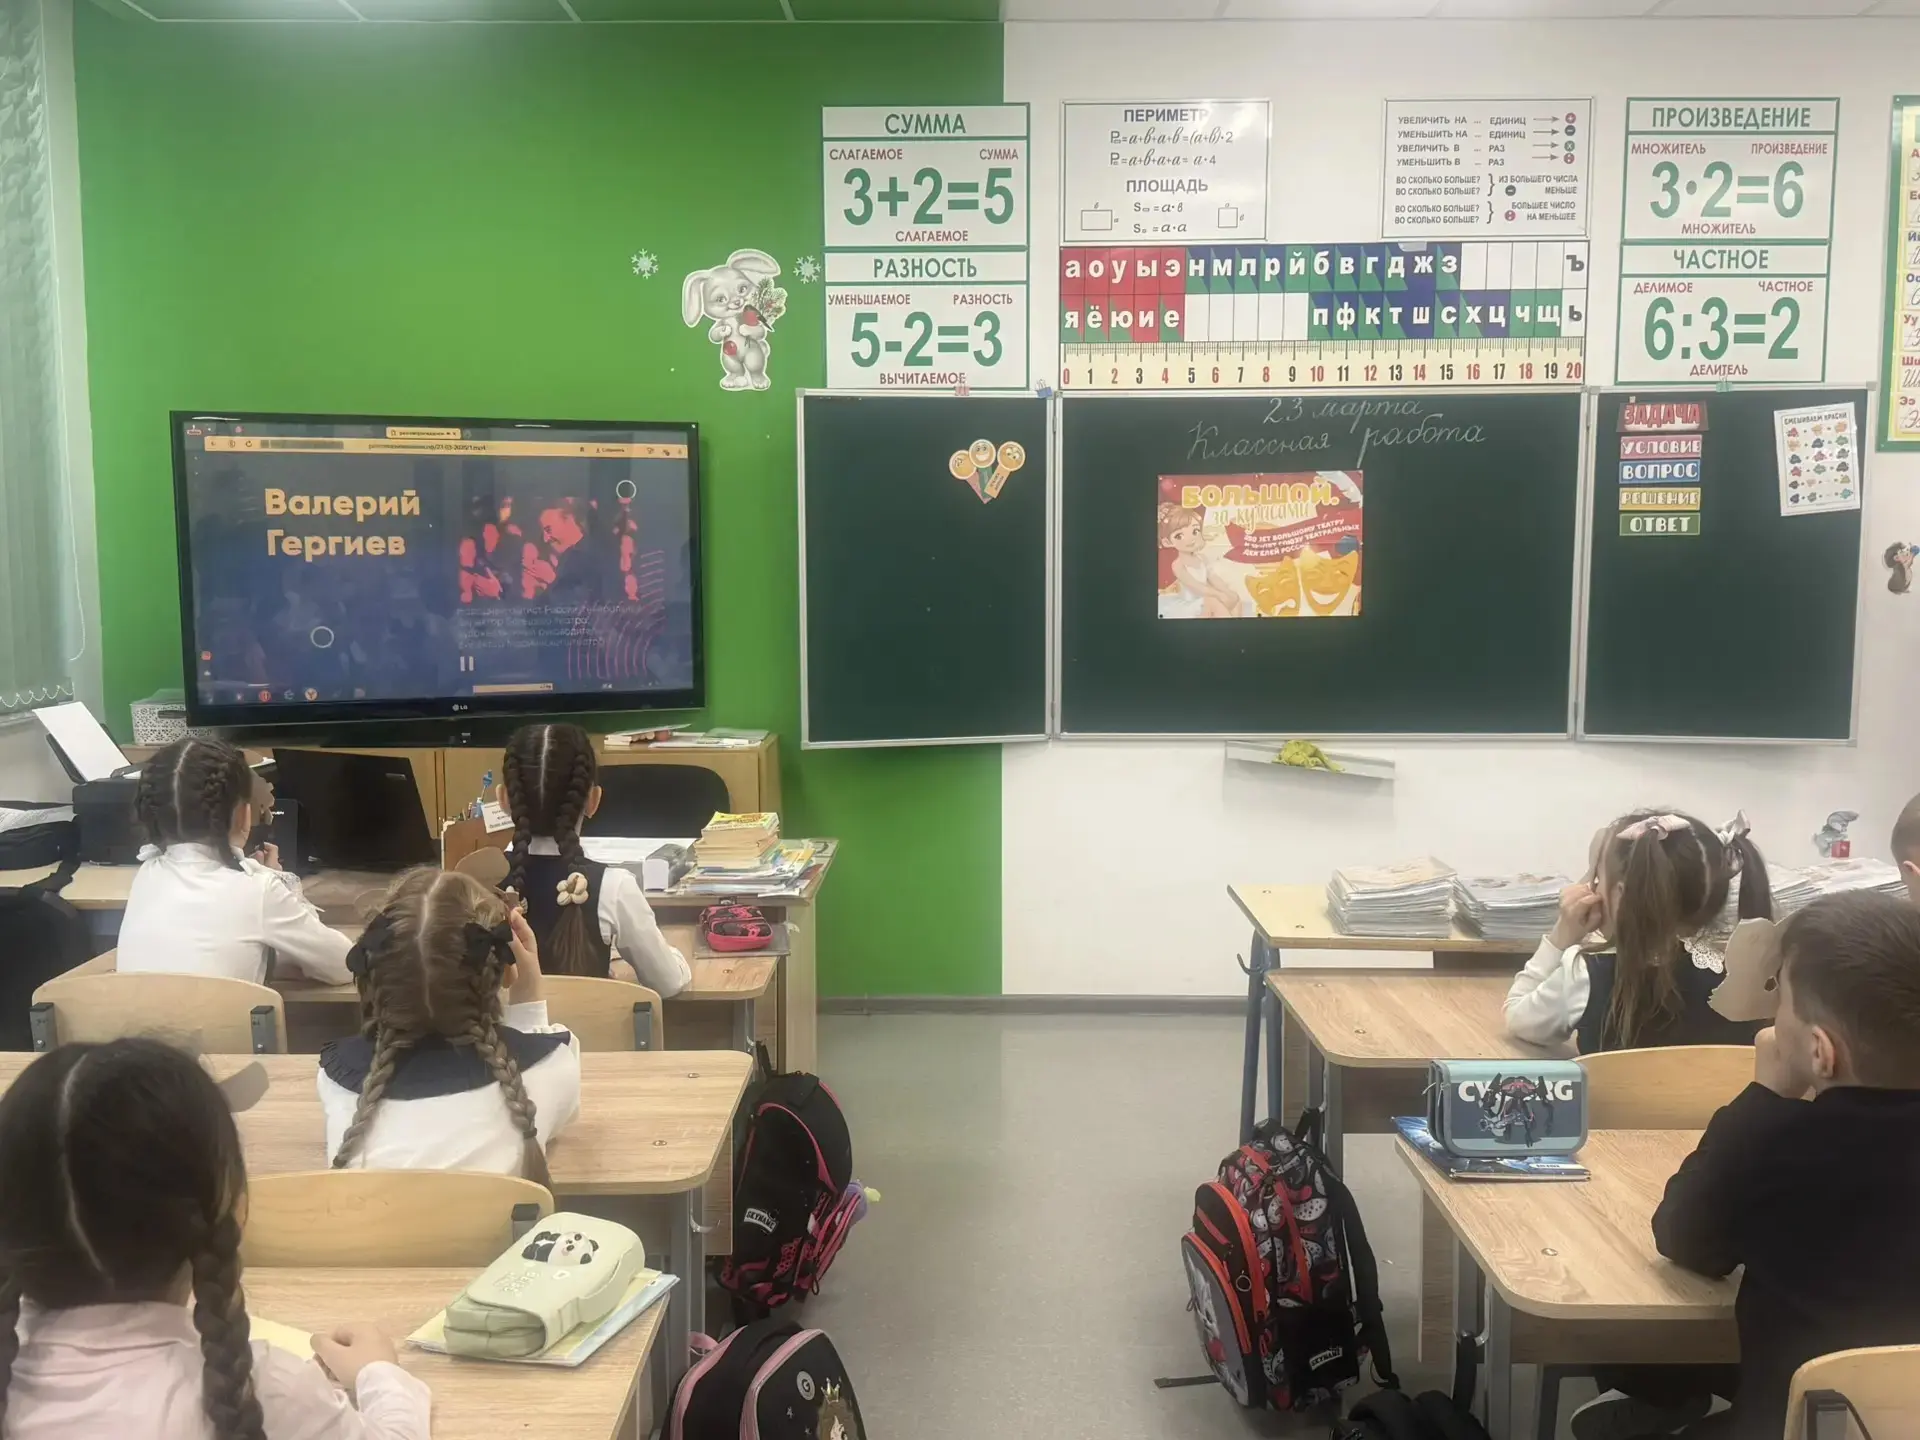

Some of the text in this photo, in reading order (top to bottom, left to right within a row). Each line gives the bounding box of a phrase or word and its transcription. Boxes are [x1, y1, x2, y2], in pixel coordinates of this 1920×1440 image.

[1124, 108, 1209, 123] ПЕРИМЕТР
[1398, 116, 1526, 126] УВЕЛИЧИТЬ НА ЕДИНИЦ
[1652, 107, 1811, 130] ПРОИЗВЕДЕНИЕ
[885, 113, 967, 135] СУММА
[1398, 130, 1453, 138] УМЕНЬШИТЬ
[1489, 131, 1526, 140] ЕДИНИЦ
[829, 148, 1019, 161] СЛАГАЕМОЕ СУММА
[1397, 144, 1449, 152] УВЕЛИЧИТЬ
[1454, 144, 1460, 152] В
[1631, 142, 1828, 156] МНОЖИТЕЛЬ ПРОИЗВЕДЕНИЕ
[1397, 158, 1505, 166] УМЕНЬШИТЬ В РАЗ
[1127, 179, 1208, 193] ПЛОЩАДЬ
[1396, 176, 1406, 184] ВО
[1408, 176, 1443, 184] СКОЛЬКО
[1444, 176, 1480, 184] БОЛЬШЕ?
[1510, 175, 1551, 183] БОЛЬШЕГО
[1553, 175, 1578, 183] ЧИСЛА
[1396, 187, 1406, 195] ВО
[1408, 187, 1442, 195] СКОЛЬКО
[1444, 187, 1480, 195] БОЛЬШЕ?
[1395, 201, 1576, 213] ВО СКОЛЬКО БОЛЬШЕ? БОЛЬШЕЕ ЧИСЛО
[1395, 212, 1576, 224] ВО СКОЛЬКО БОЛЬШЕ? НА МЕНЬШЕЕ
[895, 230, 968, 243] СЛАГАЕМОЕ
[1681, 222, 1756, 236] МНОЖИТЕЛЬ
[1065, 260, 1080, 277] а
[1088, 260, 1104, 277] о
[1112, 260, 1127, 283] у
[1137, 259, 1157, 276] ы
[1165, 259, 1181, 276] э
[1189, 258, 1205, 276] н
[1212, 258, 1232, 276] м
[1239, 258, 1257, 276] л
[1265, 258, 1281, 282] р
[1289, 251, 1305, 275] й
[1313, 251, 1329, 275] б
[1339, 256, 1355, 274] в
[1366, 256, 1378, 274] г
[1388, 256, 1405, 278] д
[1413, 256, 1433, 274] ж
[1441, 255, 1458, 273] з
[1673, 249, 1769, 270] ЧАСТНОЕ
[873, 258, 977, 279] РАЗНОСТЬ
[1633, 280, 1814, 295] ДЕЛИМОЕ ЧАСТНОЕ
[828, 292, 1013, 306] УМЕНЬШАЕМОЕ РАЗНОСТЬ
[1064, 311, 1079, 328] я
[1087, 306, 1102, 328] ё
[1111, 310, 1133, 328] ю
[1139, 310, 1154, 327] и
[1164, 310, 1179, 328] е
[1313, 308, 1328, 326] п
[1336, 302, 1356, 331] ф
[1365, 307, 1381, 325] к
[1389, 307, 1403, 324] т
[1413, 307, 1430, 324] ш
[1441, 306, 1457, 324] с
[1465, 306, 1482, 323] х
[1490, 306, 1506, 327] ц
[1515, 306, 1530, 322] ч
[1537, 305, 1560, 326] щ
[1063, 362, 1582, 384] 0 1 2 3 4 5 6 7 8 9 10 11 12 13 14 15 16 17 18 19 20
[1690, 363, 1749, 377] ДЕЛИТЕЛЬ
[879, 372, 966, 386] ВЫЧИТАЕМОЕ
[1263, 397, 1424, 434] 23 марта
[1624, 403, 1700, 427] ЗАДАЧА
[1187, 413, 1487, 468] Классная работа
[1623, 440, 1701, 455] УСЛОВИЕ
[1623, 463, 1697, 479] ВОПРОС
[265, 488, 420, 521] Валерий
[1621, 491, 1698, 505] РЕШЕНИЕ
[1272, 525, 1316, 541] БОЛЬШОМУ
[1317, 518, 1345, 530] ТЕАТРУ
[1630, 517, 1690, 532] ОТВЕТ
[267, 529, 406, 562] Гергиев
